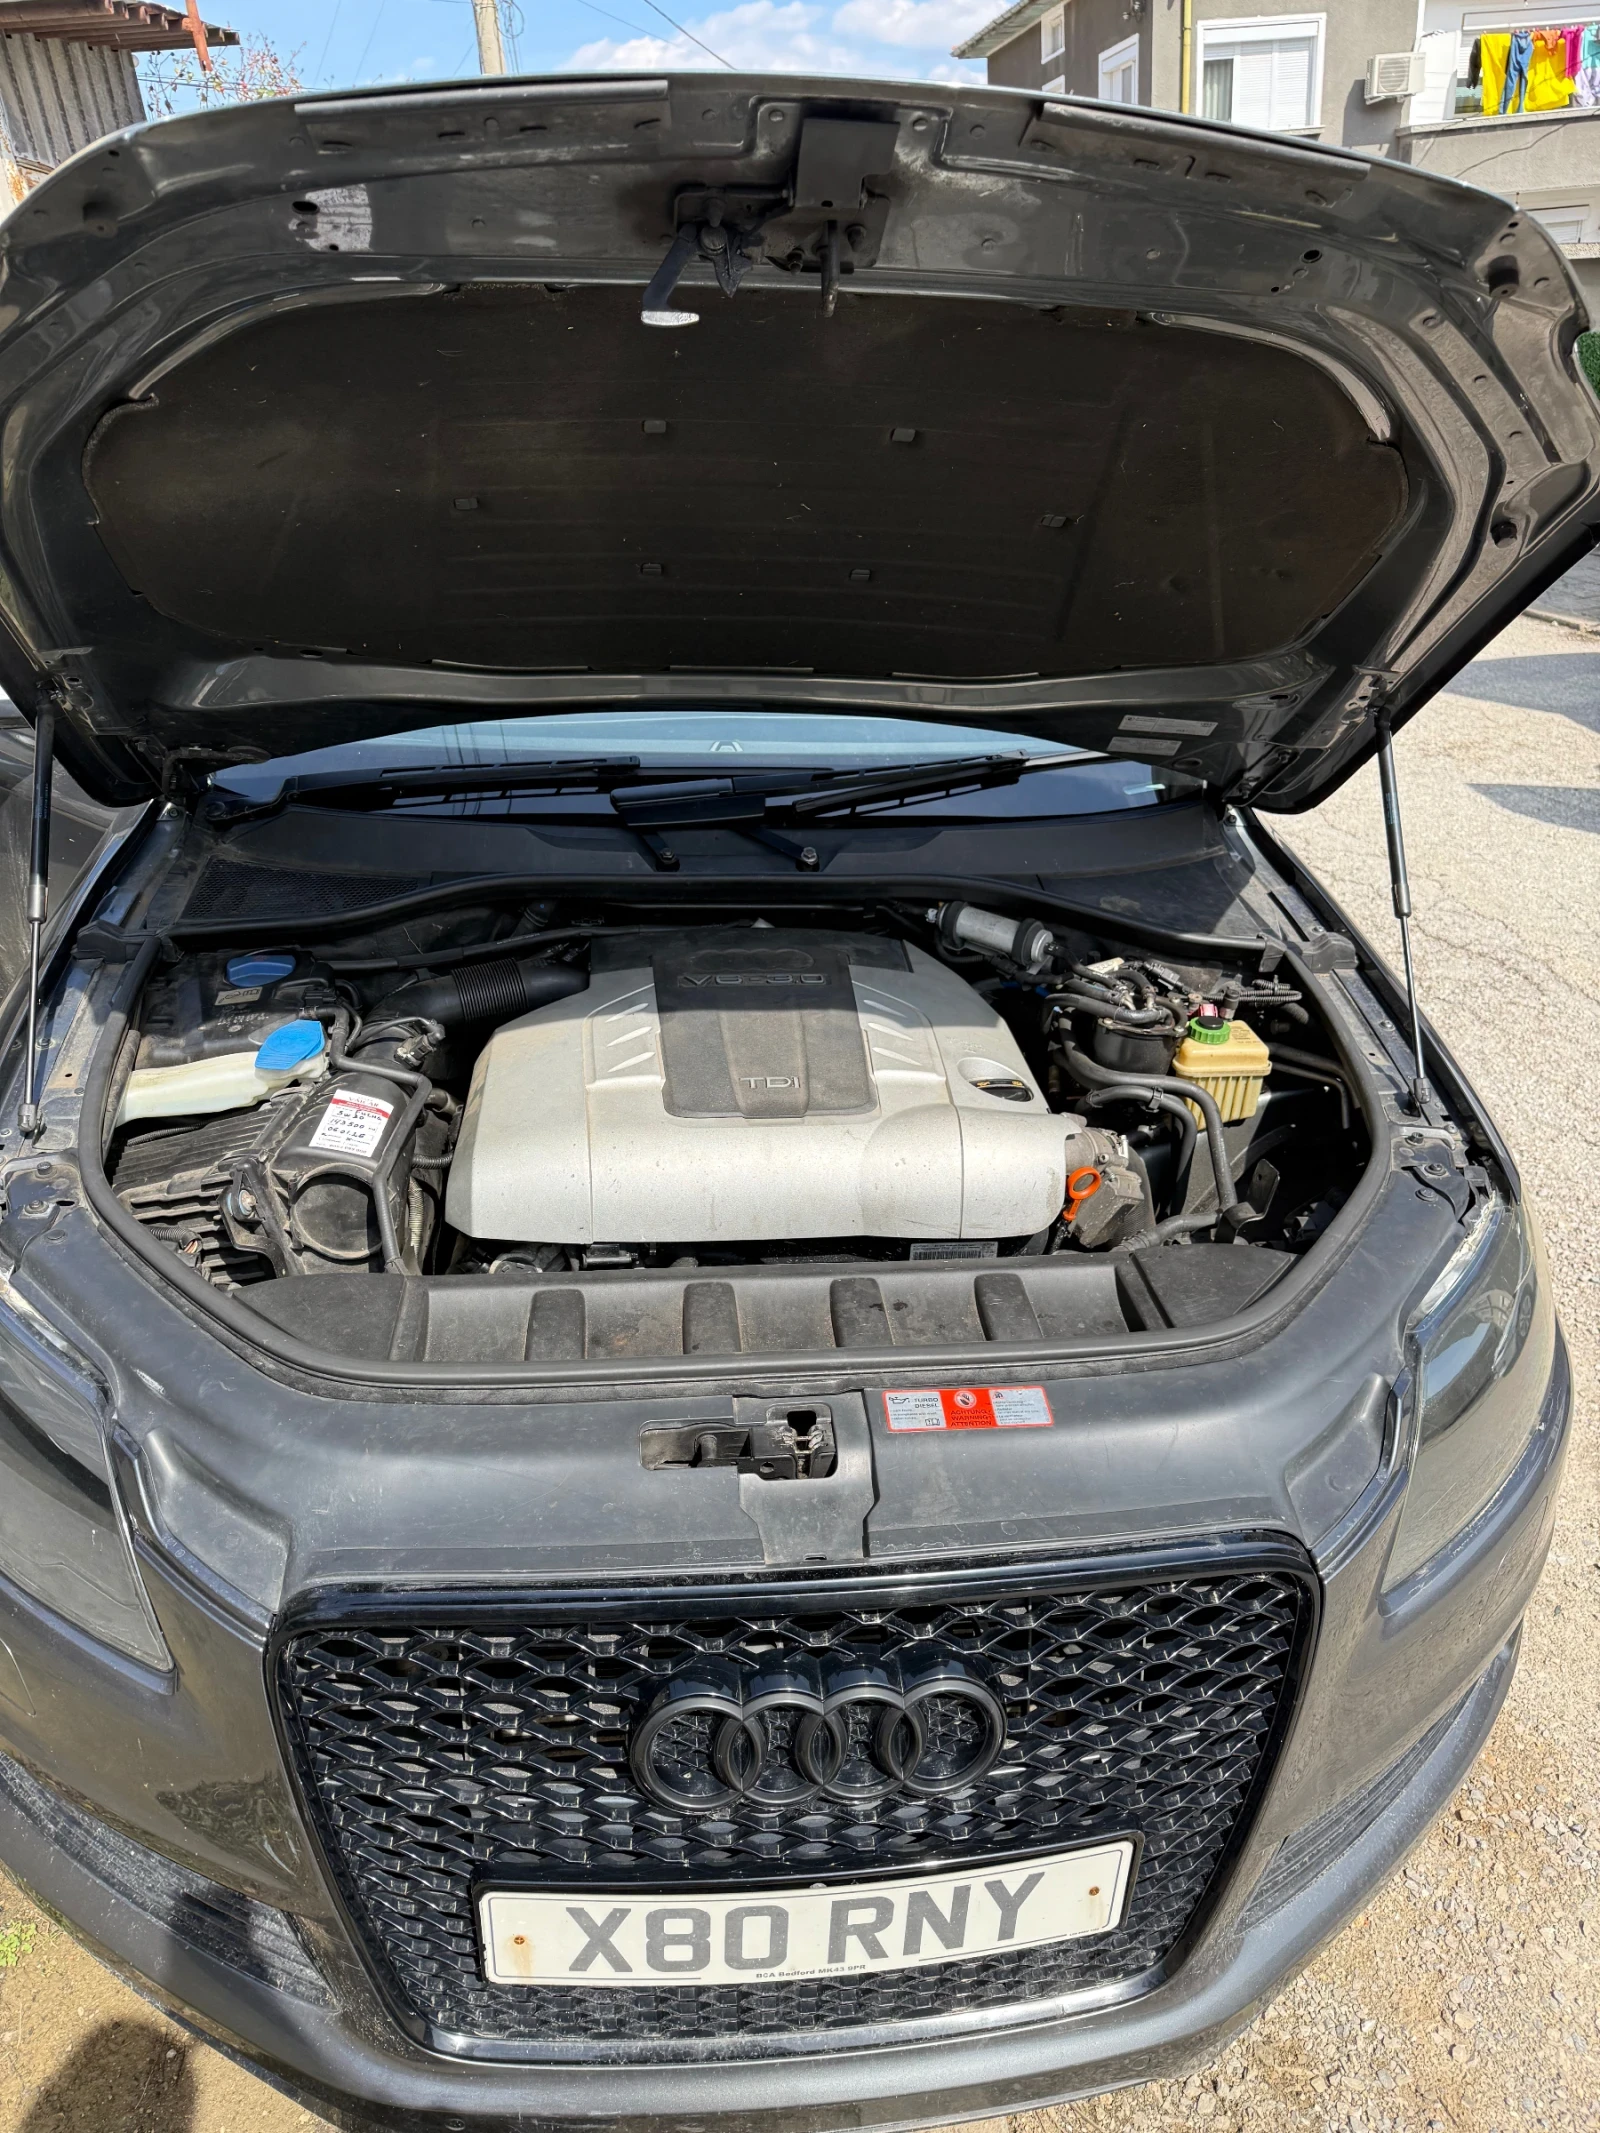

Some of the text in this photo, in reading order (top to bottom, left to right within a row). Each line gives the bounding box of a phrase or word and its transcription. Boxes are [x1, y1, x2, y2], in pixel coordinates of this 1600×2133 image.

[739, 1076, 801, 1089] TDI
[565, 1872, 1046, 1973] X80 RNY
[779, 1969, 816, 1977] Bedford
[818, 1966, 845, 1974] MK43
